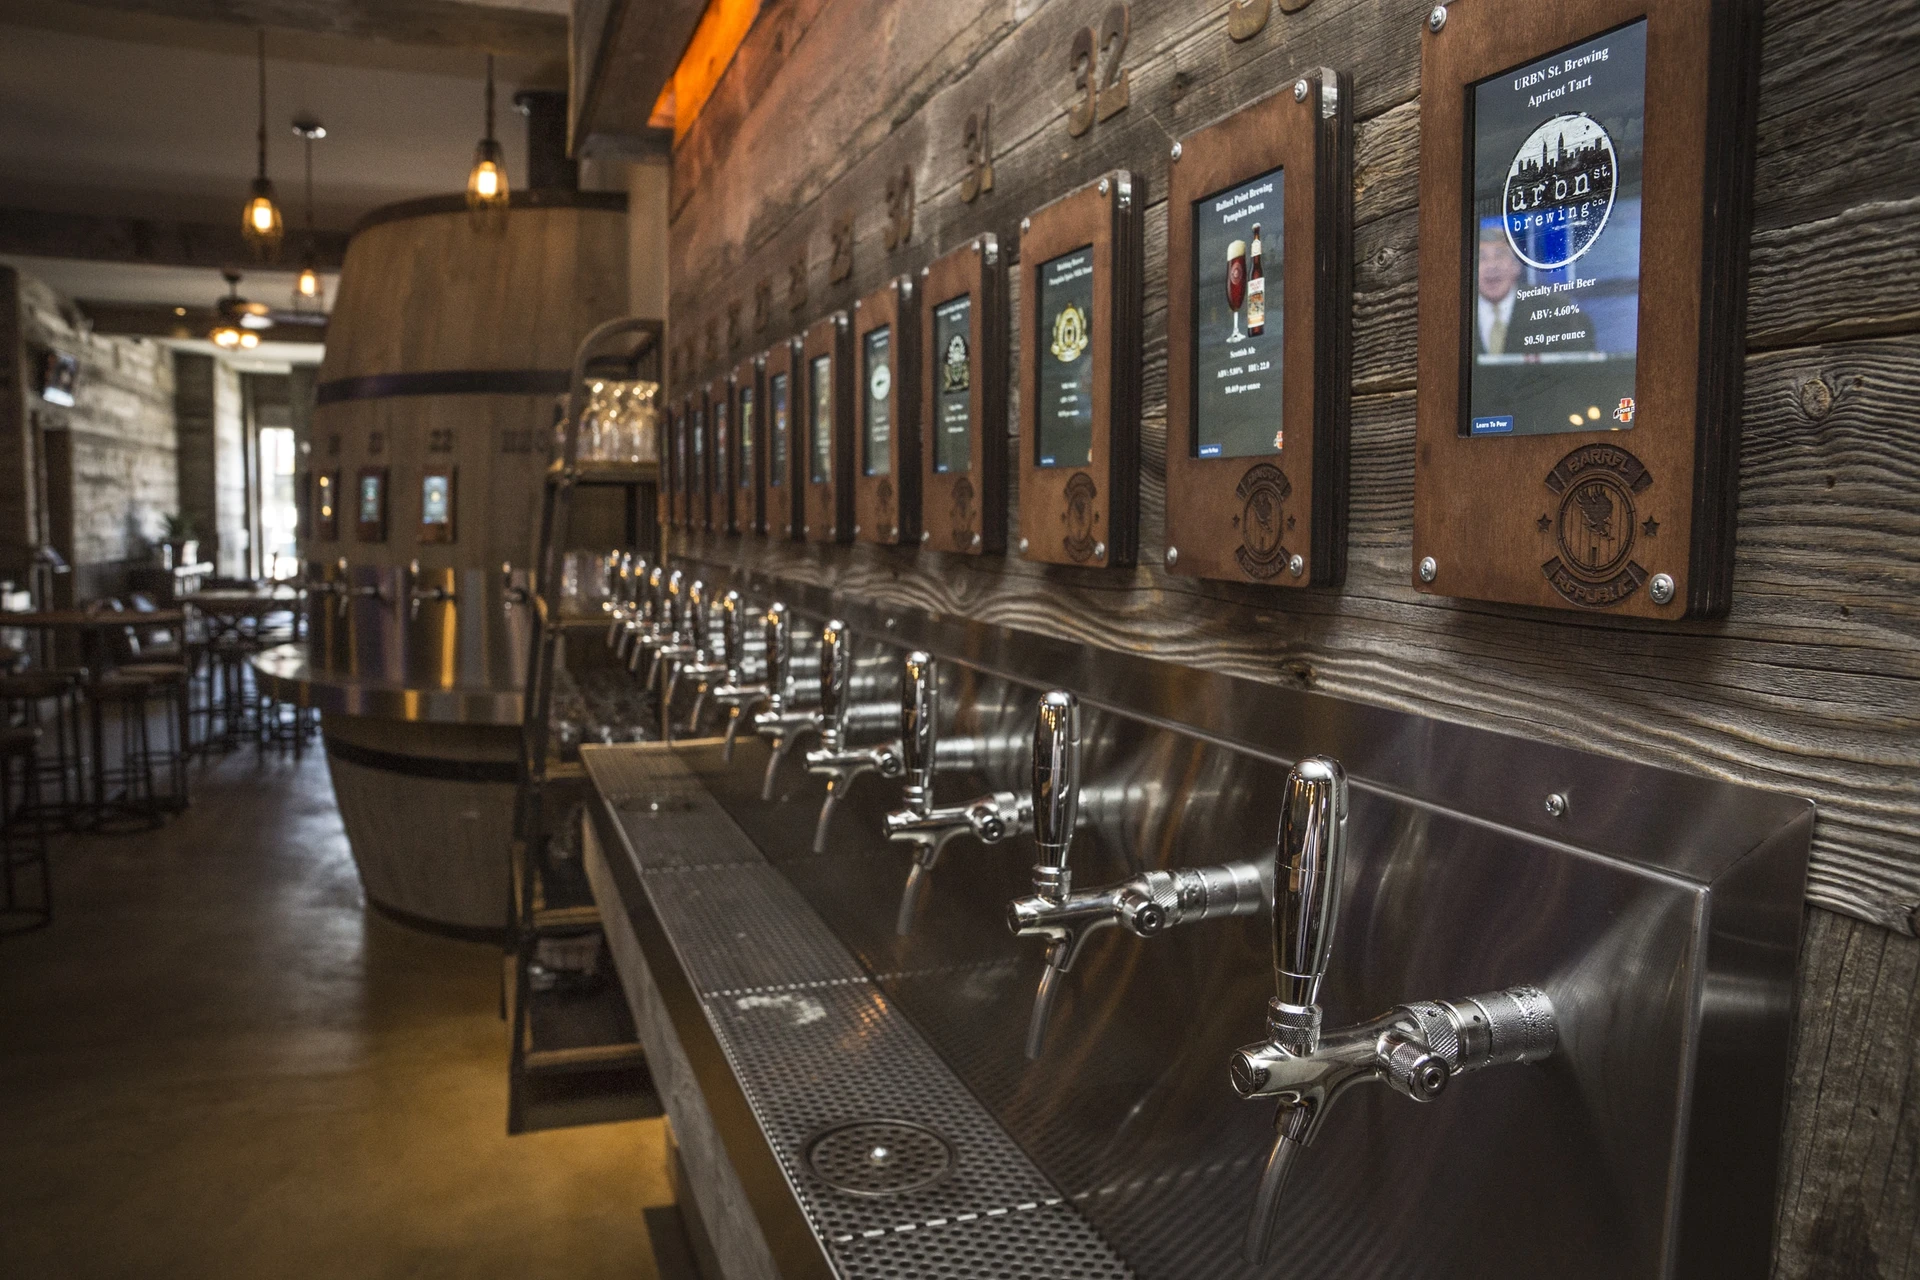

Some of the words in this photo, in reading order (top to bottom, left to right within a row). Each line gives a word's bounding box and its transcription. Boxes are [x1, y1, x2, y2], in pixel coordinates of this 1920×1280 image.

[1068, 3, 1130, 138] 32
[1514, 69, 1546, 91] URBN
[1548, 65, 1562, 79] St.
[1564, 48, 1609, 73] Brewing
[1527, 85, 1566, 108] Apricot
[1568, 75, 1593, 93] Tart
[961, 102, 994, 204] 31
[1249, 183, 1273, 198] Brewing
[1511, 173, 1590, 211] urbn
[1593, 164, 1611, 179] st.
[1513, 203, 1589, 231] brewing
[1517, 285, 1552, 300] Specialty
[1553, 280, 1574, 292] Fruit
[1576, 278, 1596, 288] Beer
[1530, 308, 1553, 321] ABV:
[1554, 304, 1580, 317] 4.60%
[1524, 333, 1545, 346] $0.50
[1546, 334, 1560, 345] per
[1561, 330, 1586, 340] ounce
[1567, 448, 1630, 474] BARREL
[1554, 573, 1634, 602] REPUBLIC
